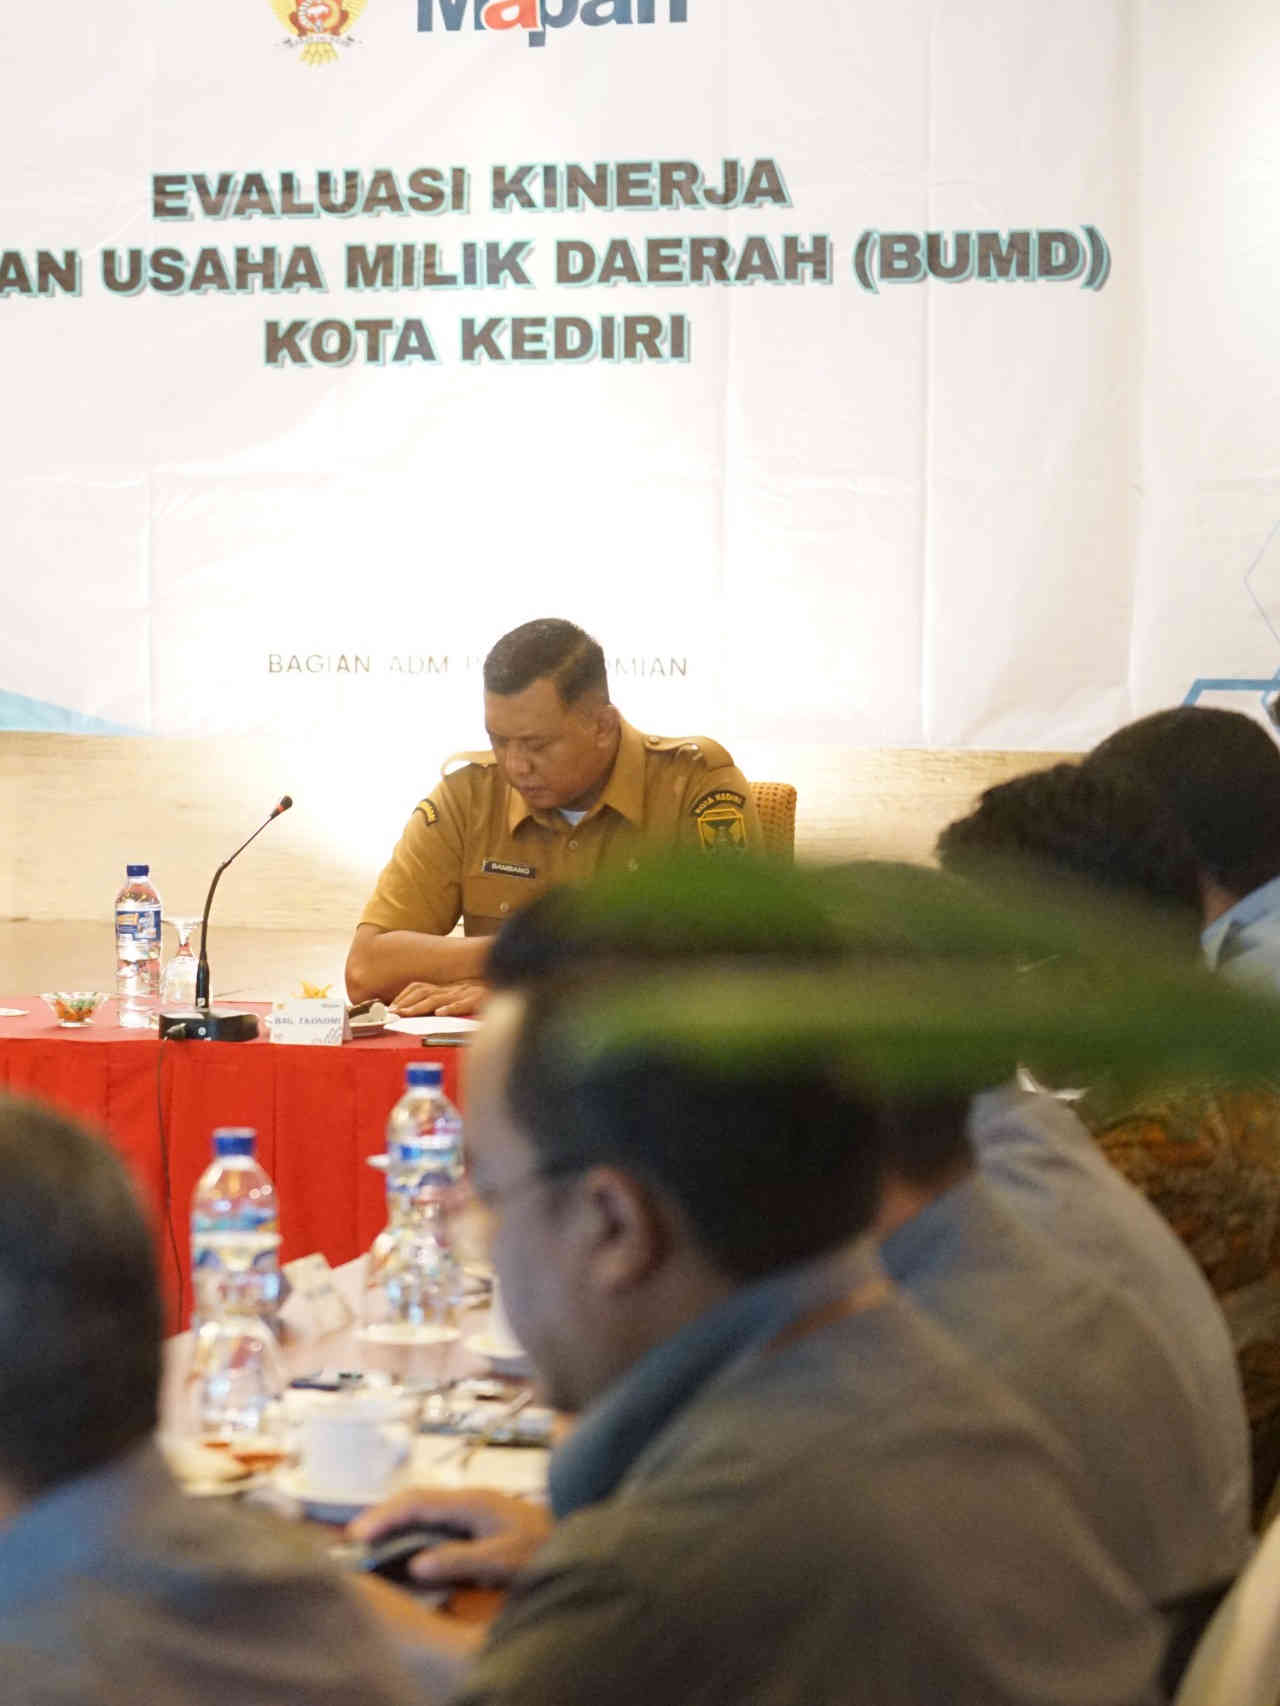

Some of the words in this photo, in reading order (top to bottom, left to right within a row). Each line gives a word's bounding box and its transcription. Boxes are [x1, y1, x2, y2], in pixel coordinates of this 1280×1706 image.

[151, 168, 470, 221] EVALUASI
[491, 159, 791, 212] KINERJA
[101, 246, 326, 296] USAHA
[344, 240, 532, 290] MILIK
[555, 234, 834, 287] DAERAH
[853, 224, 1111, 295] (BUMD)
[264, 317, 437, 367] KOTA
[460, 313, 690, 362] KEDIRI
[268, 653, 371, 674] BAGIAN
[389, 655, 449, 674] ADM
